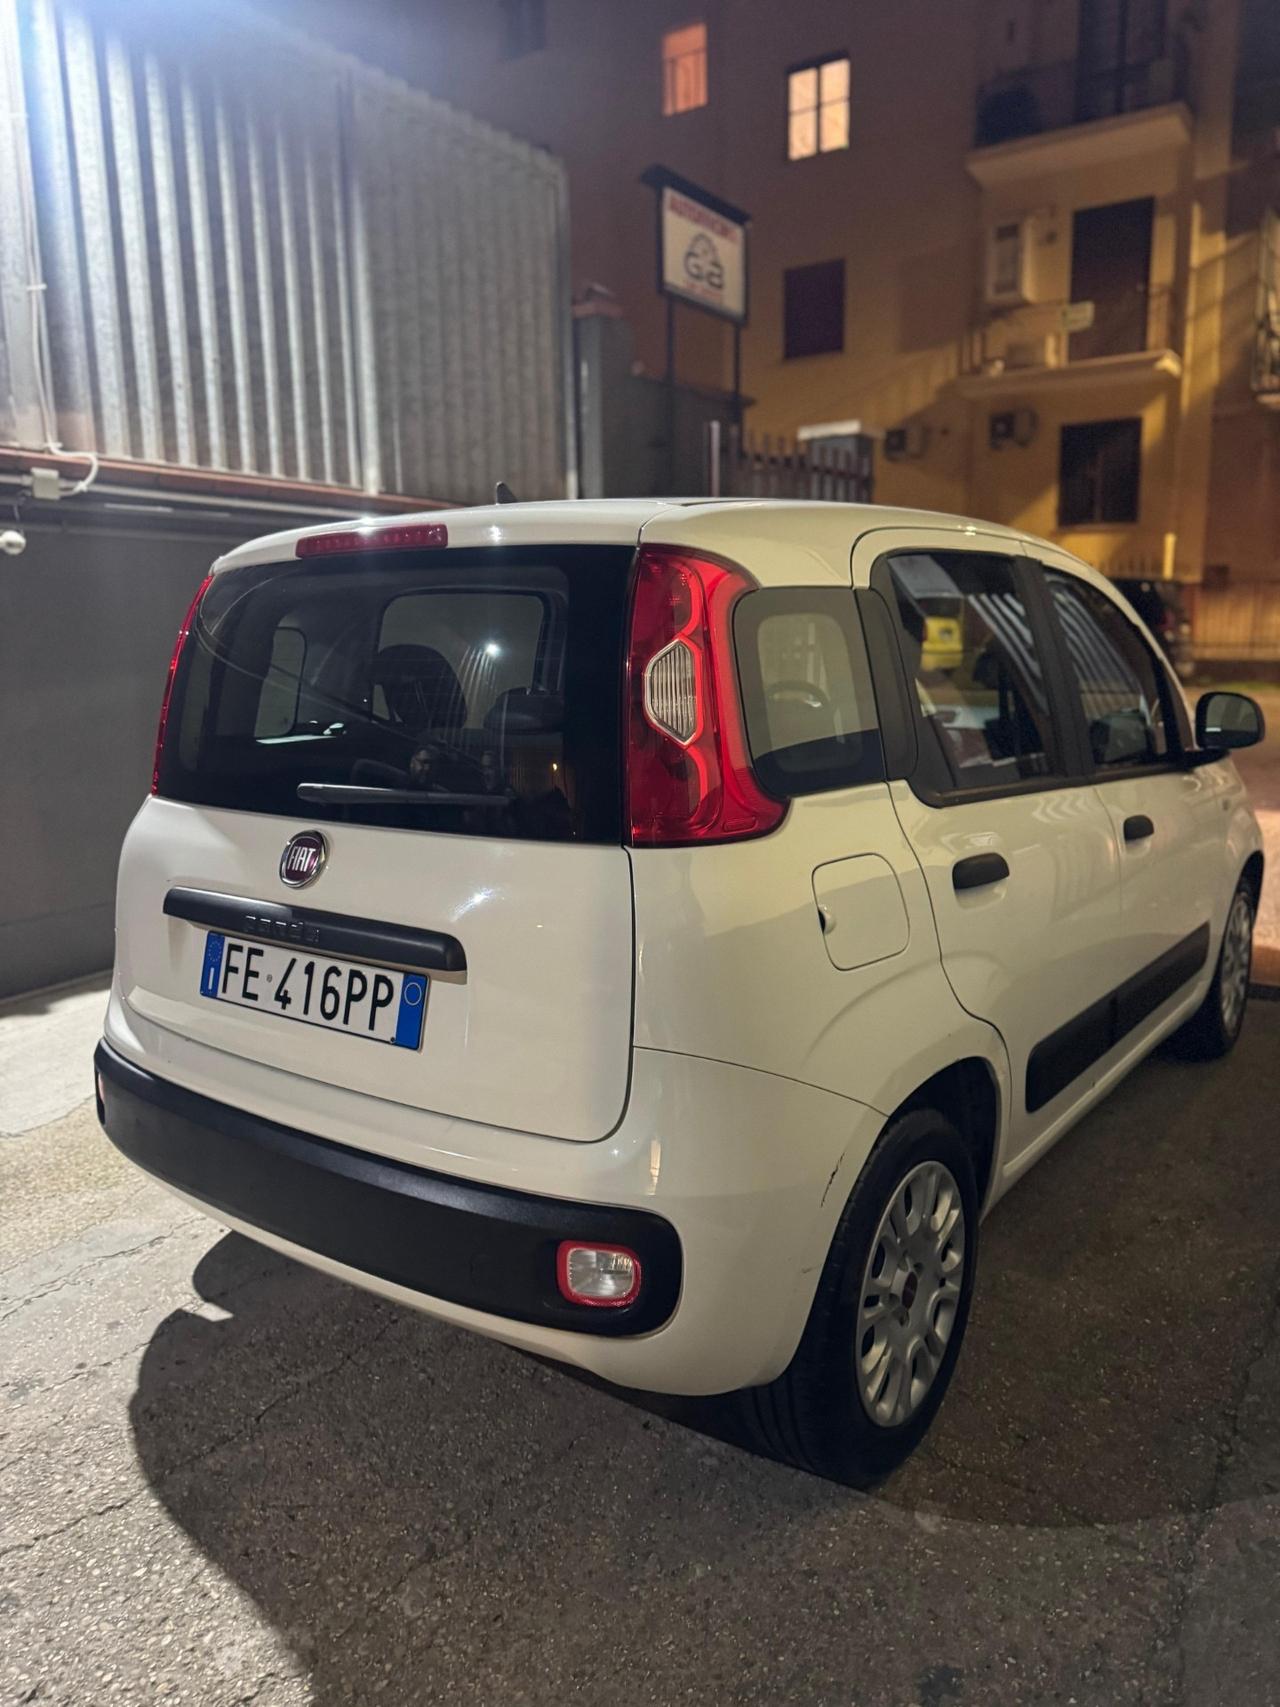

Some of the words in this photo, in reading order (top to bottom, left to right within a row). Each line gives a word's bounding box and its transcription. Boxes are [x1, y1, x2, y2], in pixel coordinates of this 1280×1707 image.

[287, 846, 316, 872] FIAT
[221, 943, 264, 1002] FE
[274, 957, 394, 1031] 416PP
